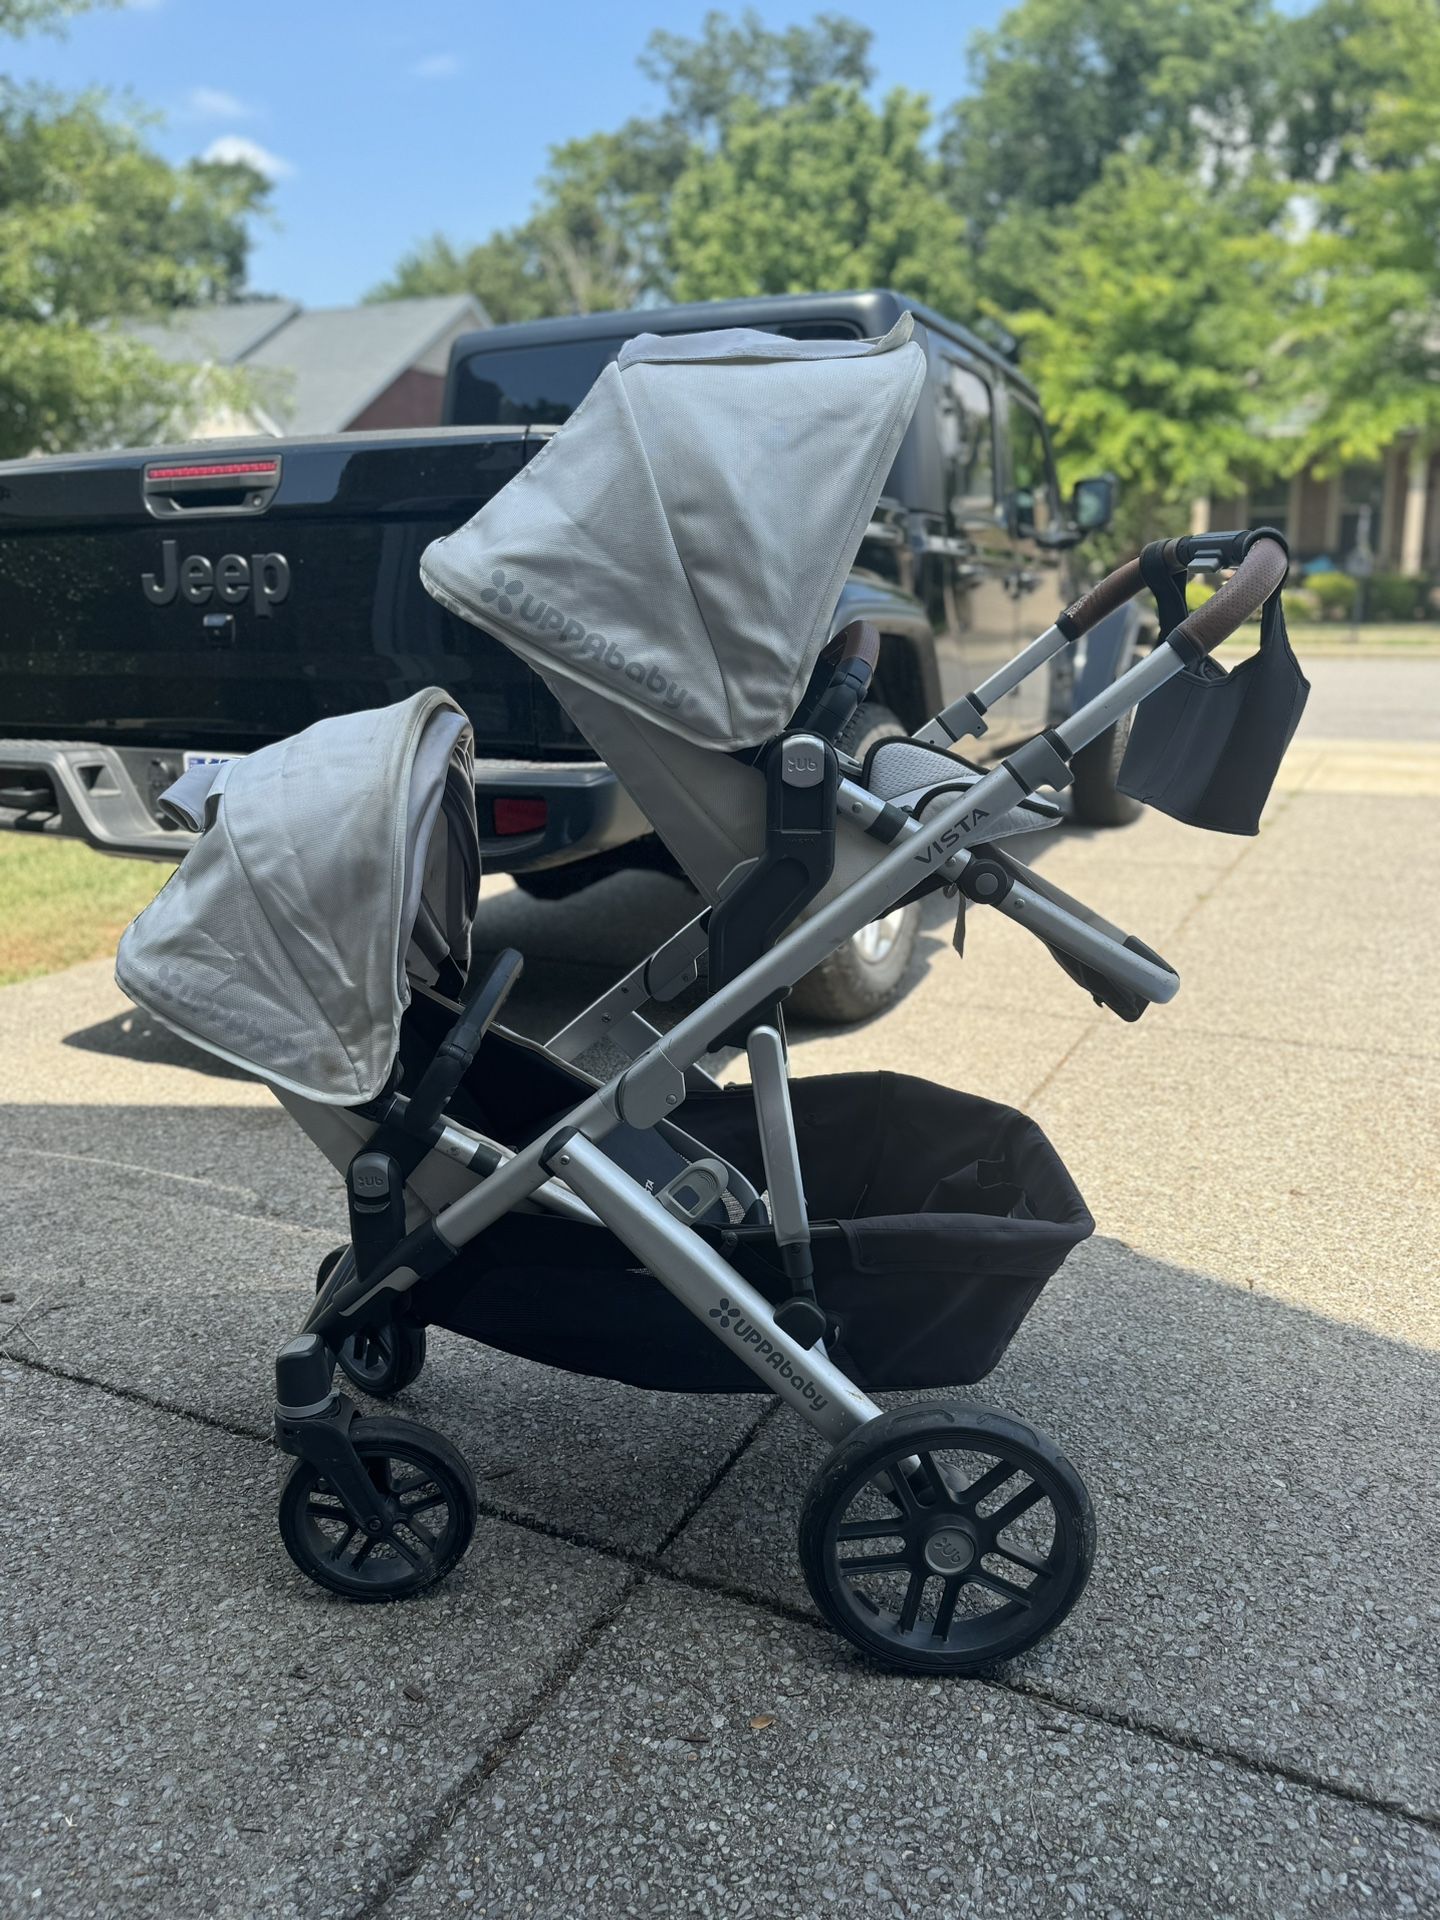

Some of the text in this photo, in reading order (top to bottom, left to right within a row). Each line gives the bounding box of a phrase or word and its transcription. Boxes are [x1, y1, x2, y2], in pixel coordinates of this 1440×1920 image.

[141, 539, 291, 618] Jeep
[519, 593, 688, 709] UPPAbaby
[914, 808, 990, 864] VISTA
[733, 1318, 829, 1412] UPPAbaby
